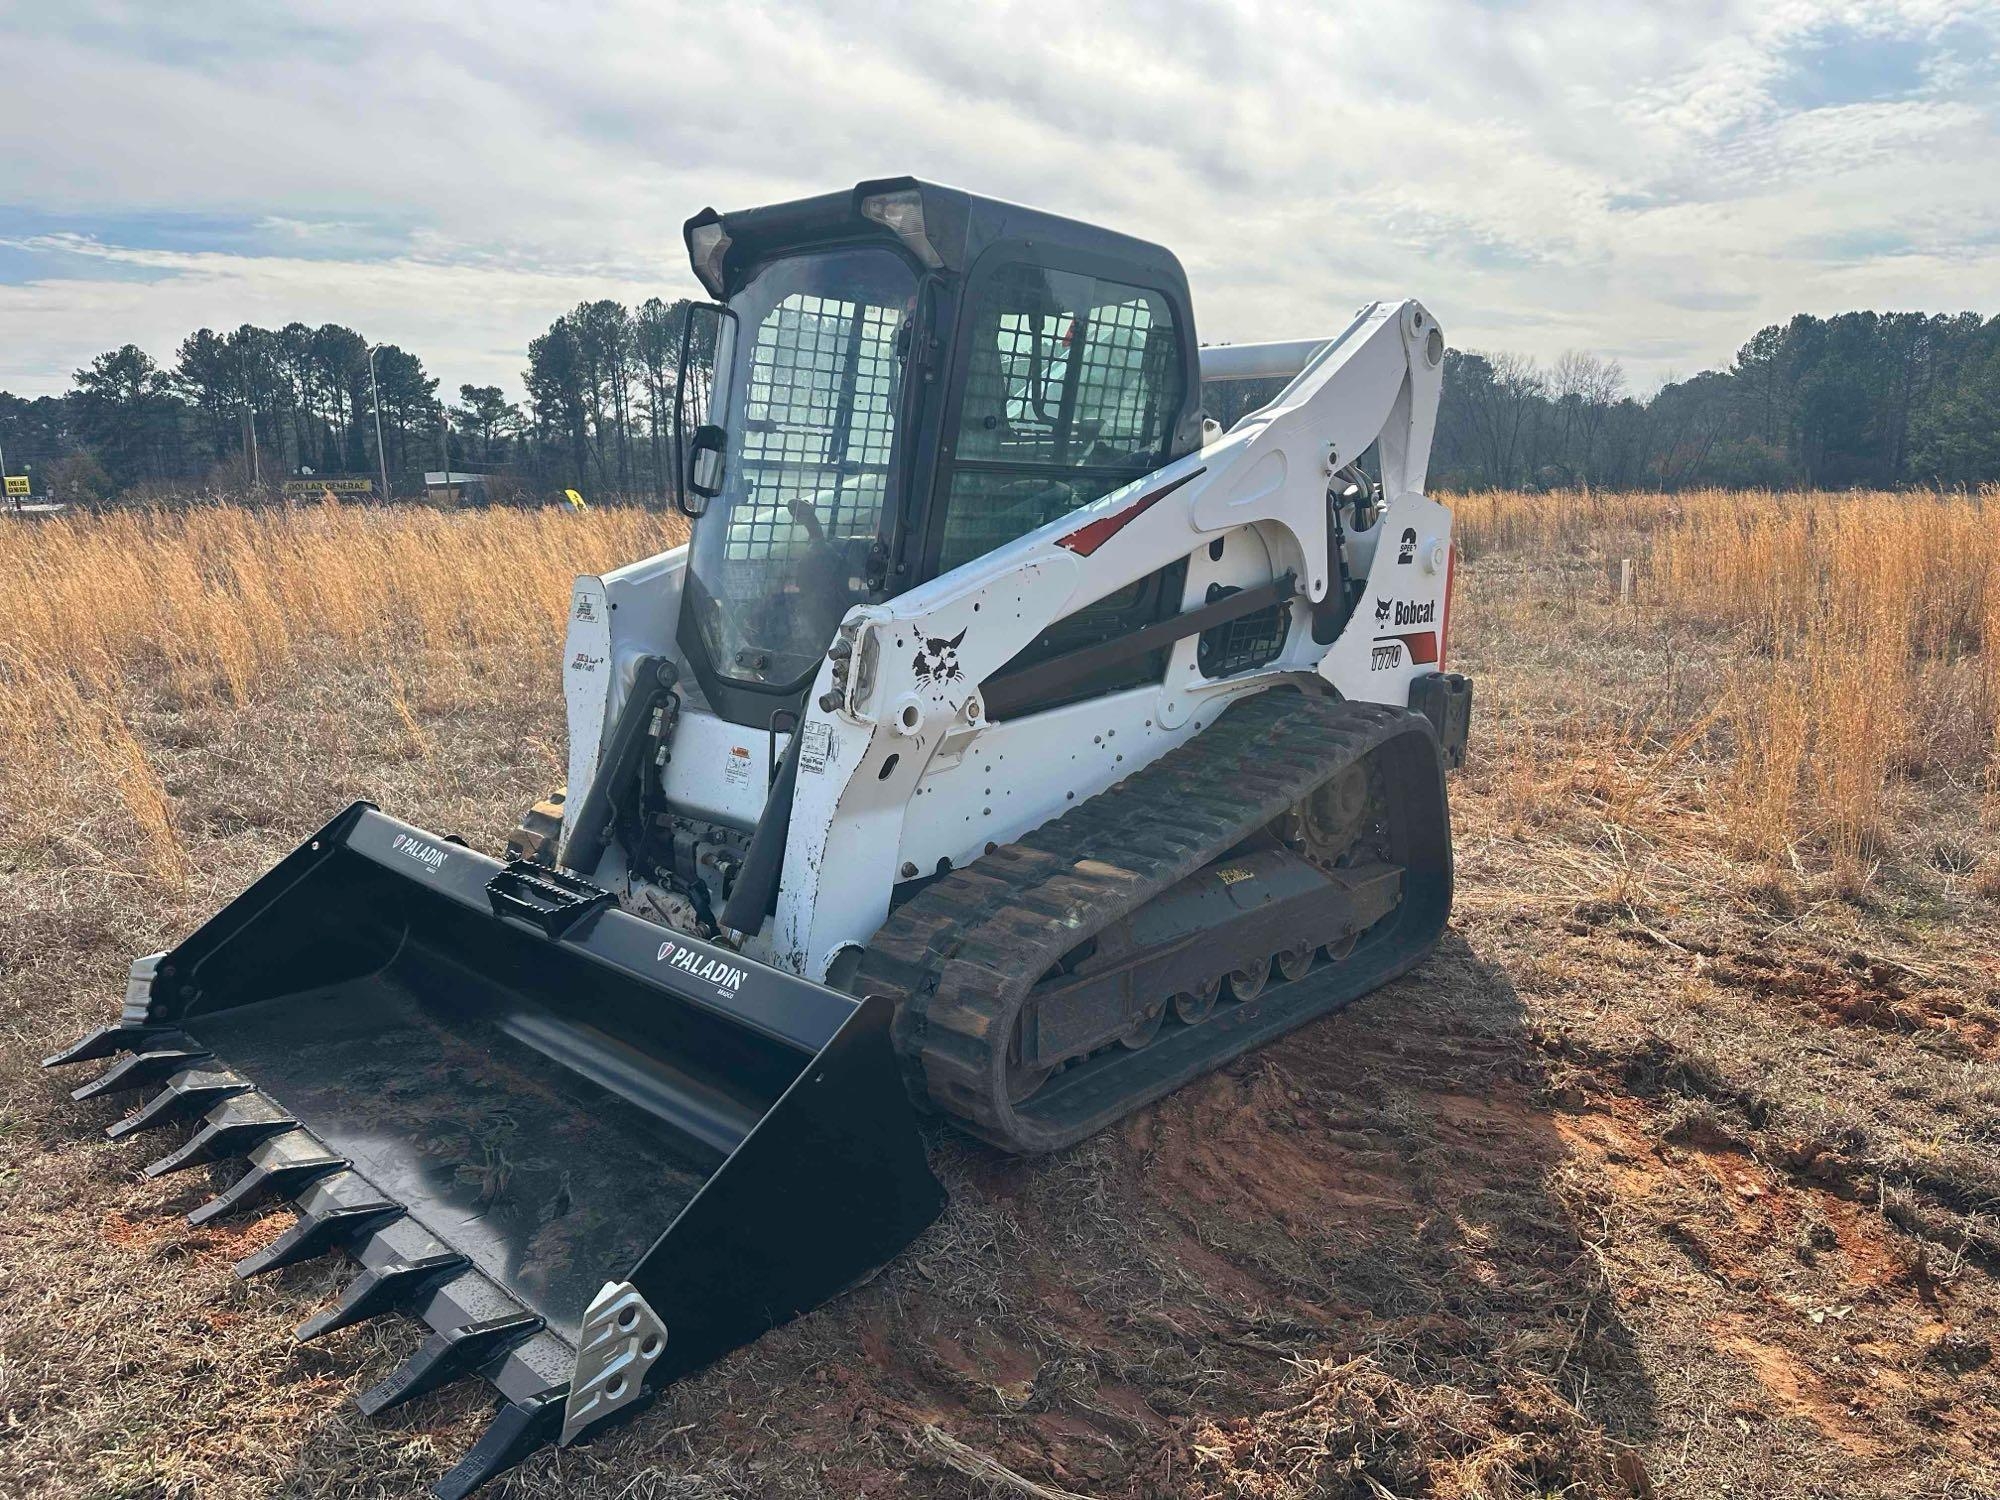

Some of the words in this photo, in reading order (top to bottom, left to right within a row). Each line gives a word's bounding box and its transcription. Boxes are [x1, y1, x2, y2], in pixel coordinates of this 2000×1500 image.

[287, 482, 323, 490] DOLLAR
[1394, 600, 1435, 626] Bobcat
[1371, 645, 1402, 671] T770
[400, 837, 449, 868] PALADIN
[670, 947, 748, 991] PALADIN
